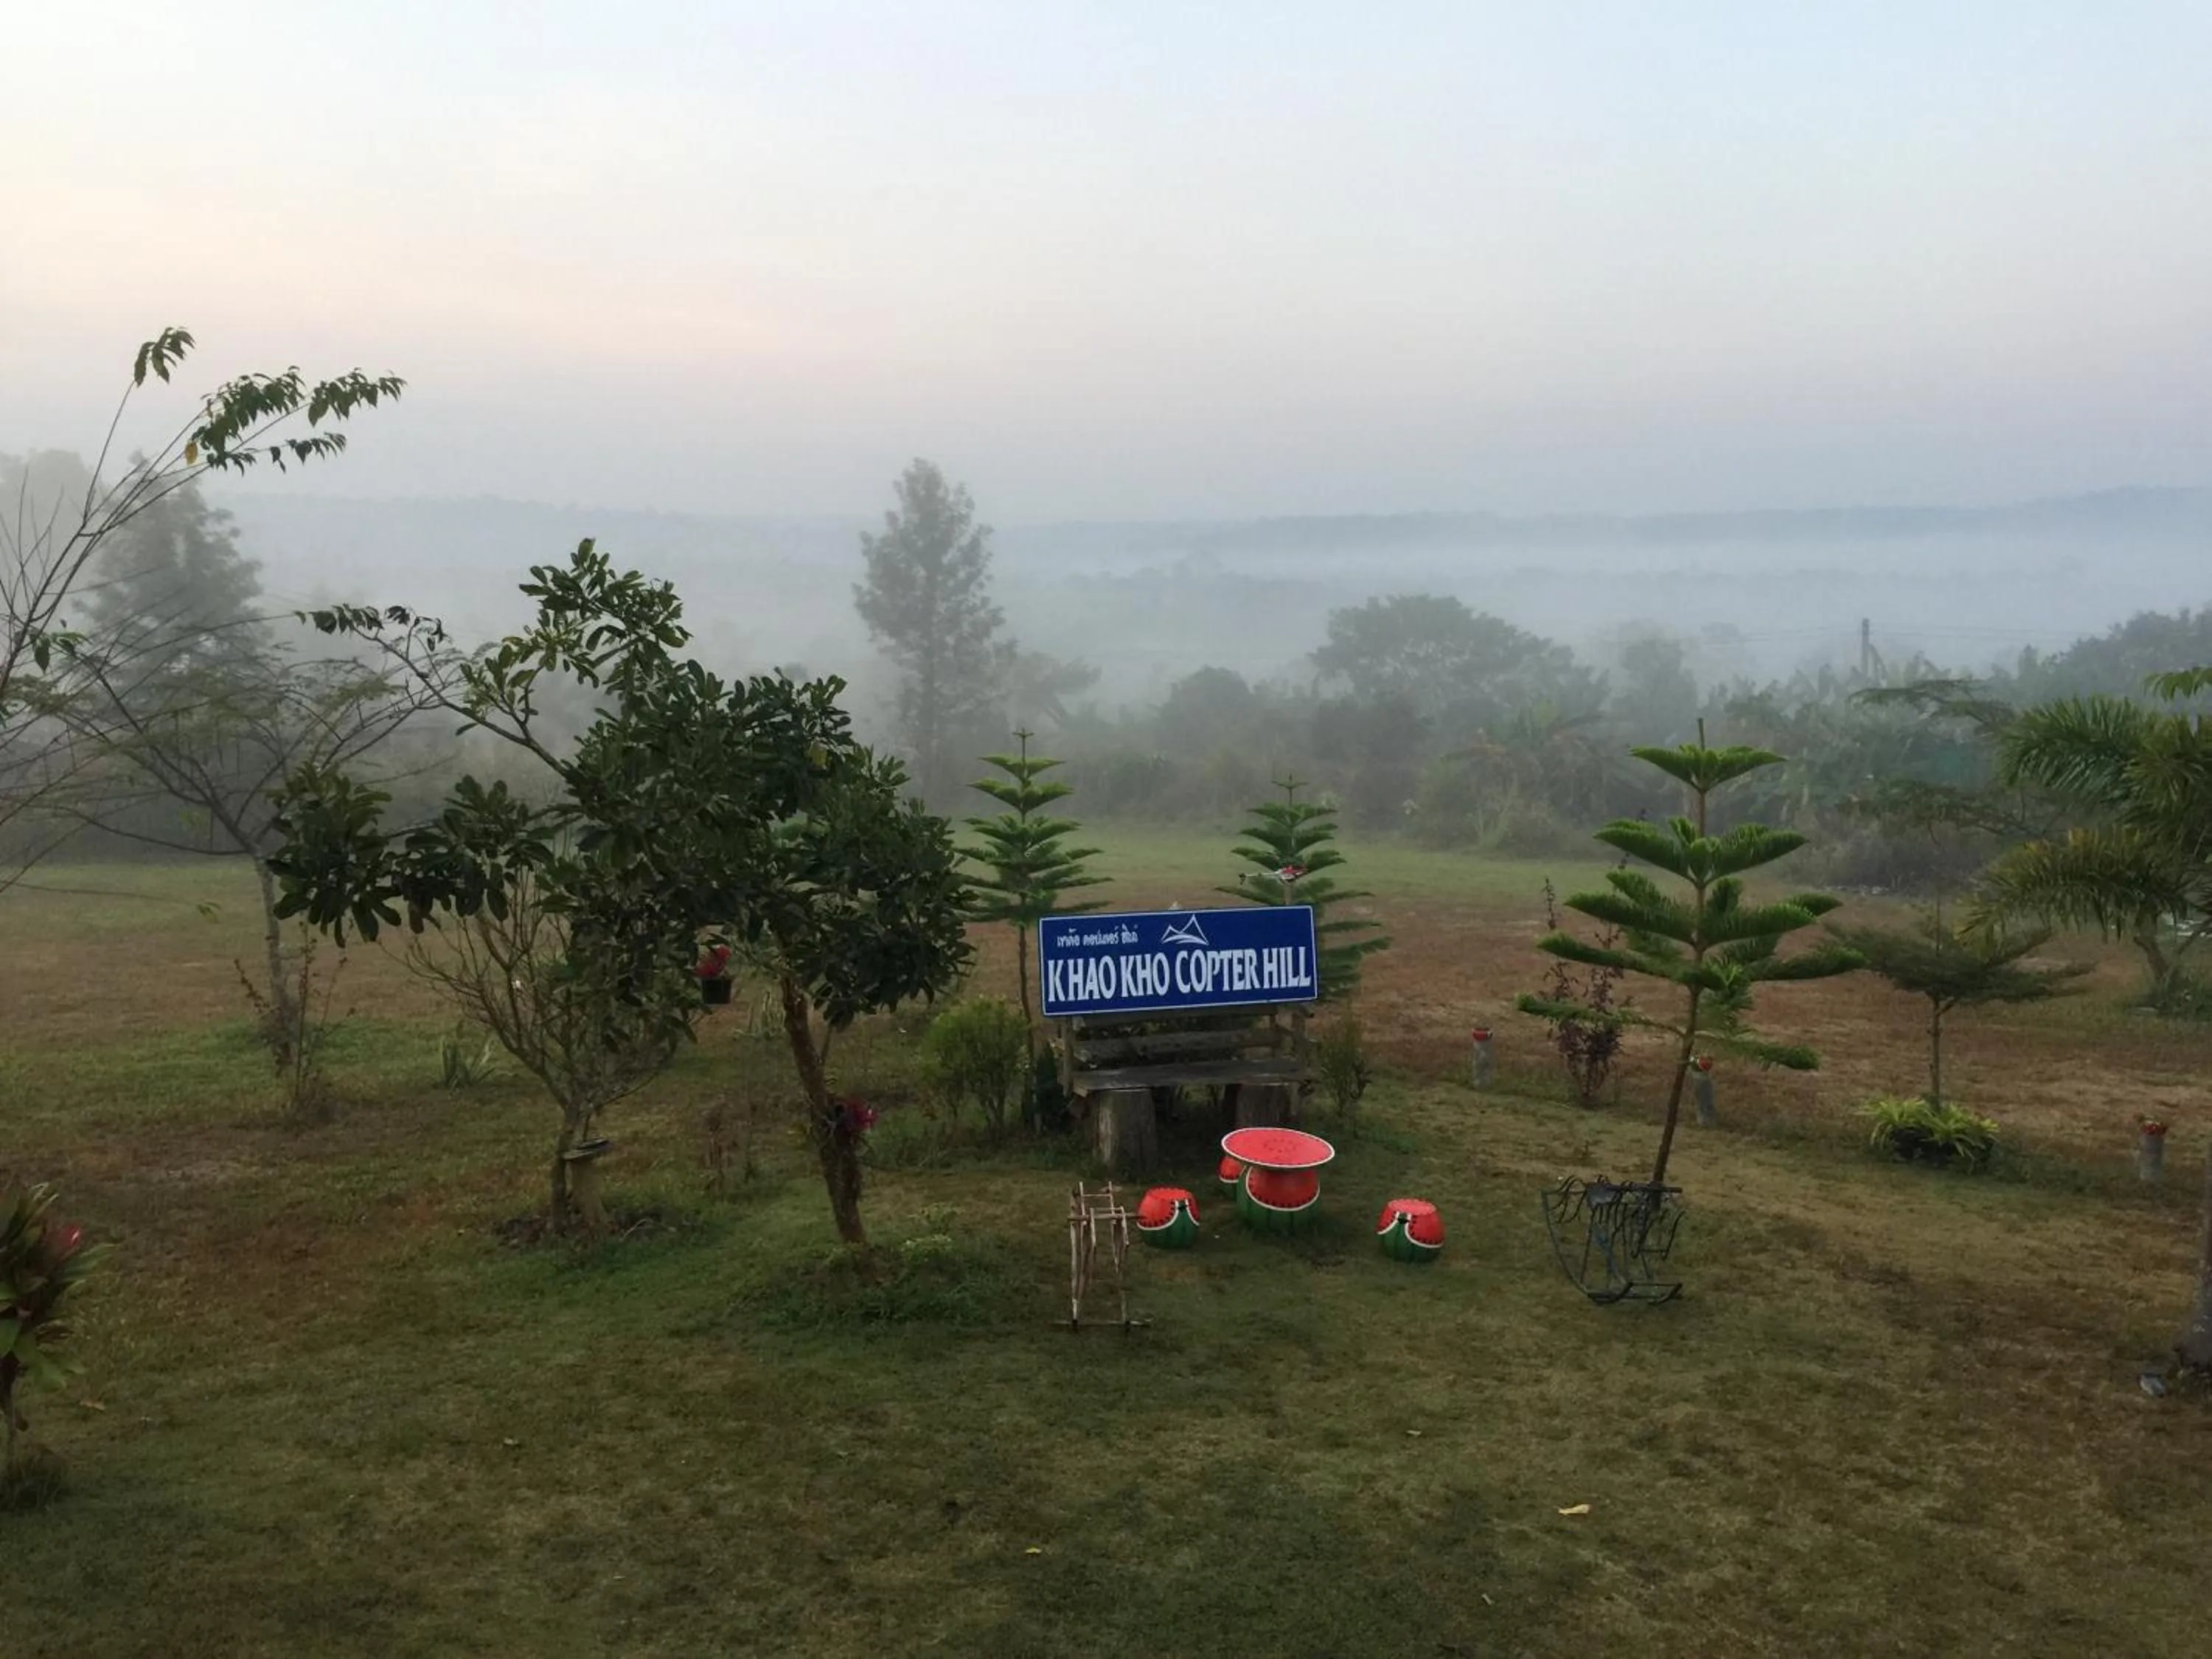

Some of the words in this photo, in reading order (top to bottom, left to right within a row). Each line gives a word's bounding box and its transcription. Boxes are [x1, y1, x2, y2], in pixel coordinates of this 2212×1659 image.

[1048, 955, 1116, 1002] KHAO
[1121, 952, 1170, 998] KHO
[1175, 948, 1260, 993] COPTER
[1263, 946, 1311, 989] HILL
